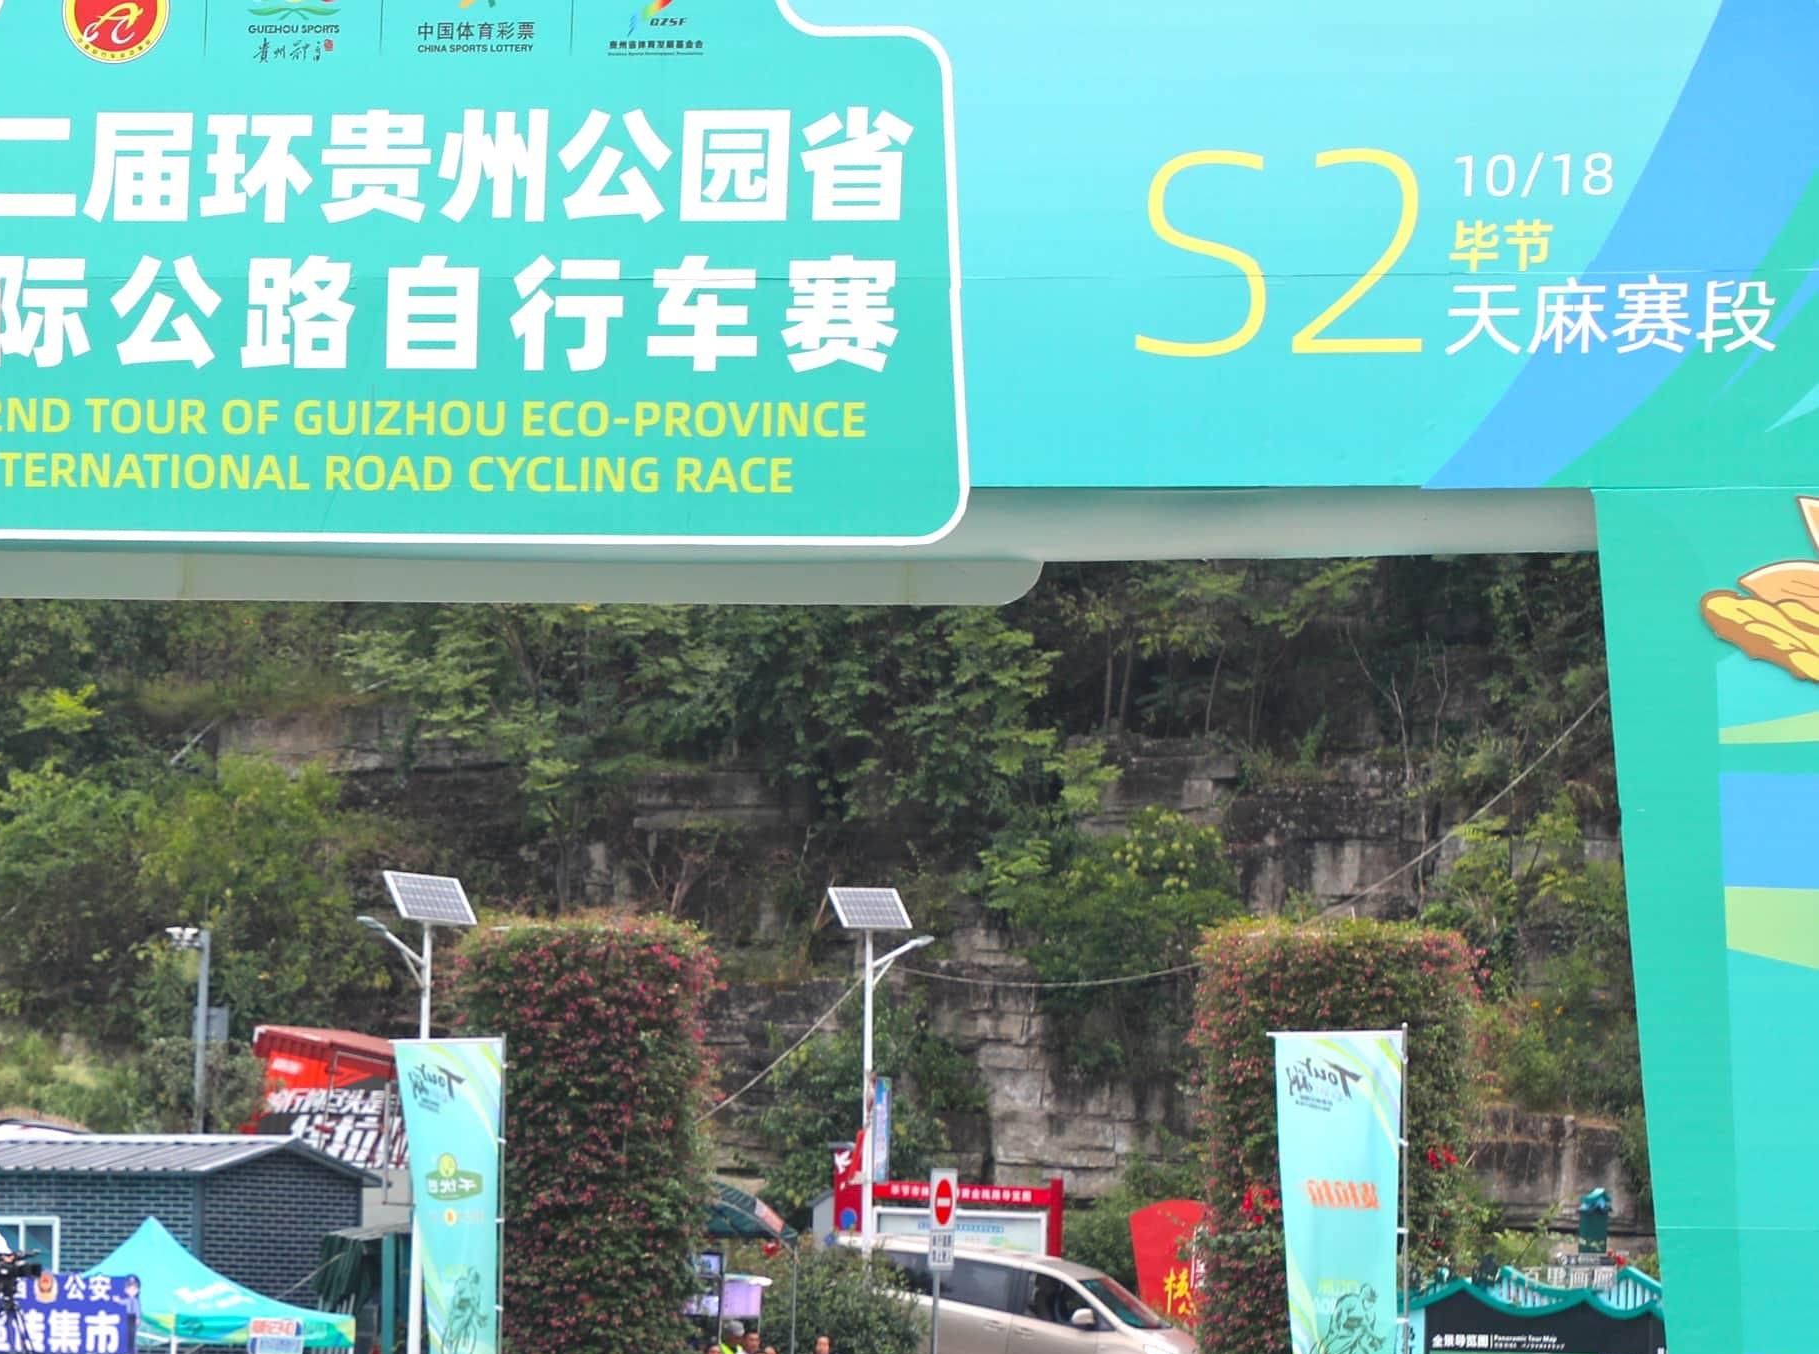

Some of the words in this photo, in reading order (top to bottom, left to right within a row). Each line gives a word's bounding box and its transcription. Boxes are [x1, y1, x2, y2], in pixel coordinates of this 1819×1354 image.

[248, 24, 299, 34] GUIZHOU
[301, 24, 340, 34] SPORTS
[417, 44, 449, 53] CHINA
[450, 44, 488, 53] SPORTS
[490, 43, 533, 53] LOTTERY
[418, 21, 535, 41] 中国体育彩票
[1454, 151, 1614, 199] 10/18
[1135, 147, 1423, 358] S2
[1448, 218, 1554, 273] 毕节
[1444, 272, 1778, 357] 天麻赛段
[84, 397, 208, 434] TOUR
[221, 398, 280, 435] OF
[293, 399, 506, 437] GUIZHOU
[521, 399, 867, 438] ECO-PROVINCE
[325, 454, 453, 492] ROAD
[468, 455, 660, 493] CYCLING
[676, 456, 794, 493] RACE
[64, 1275, 112, 1301] 公安
